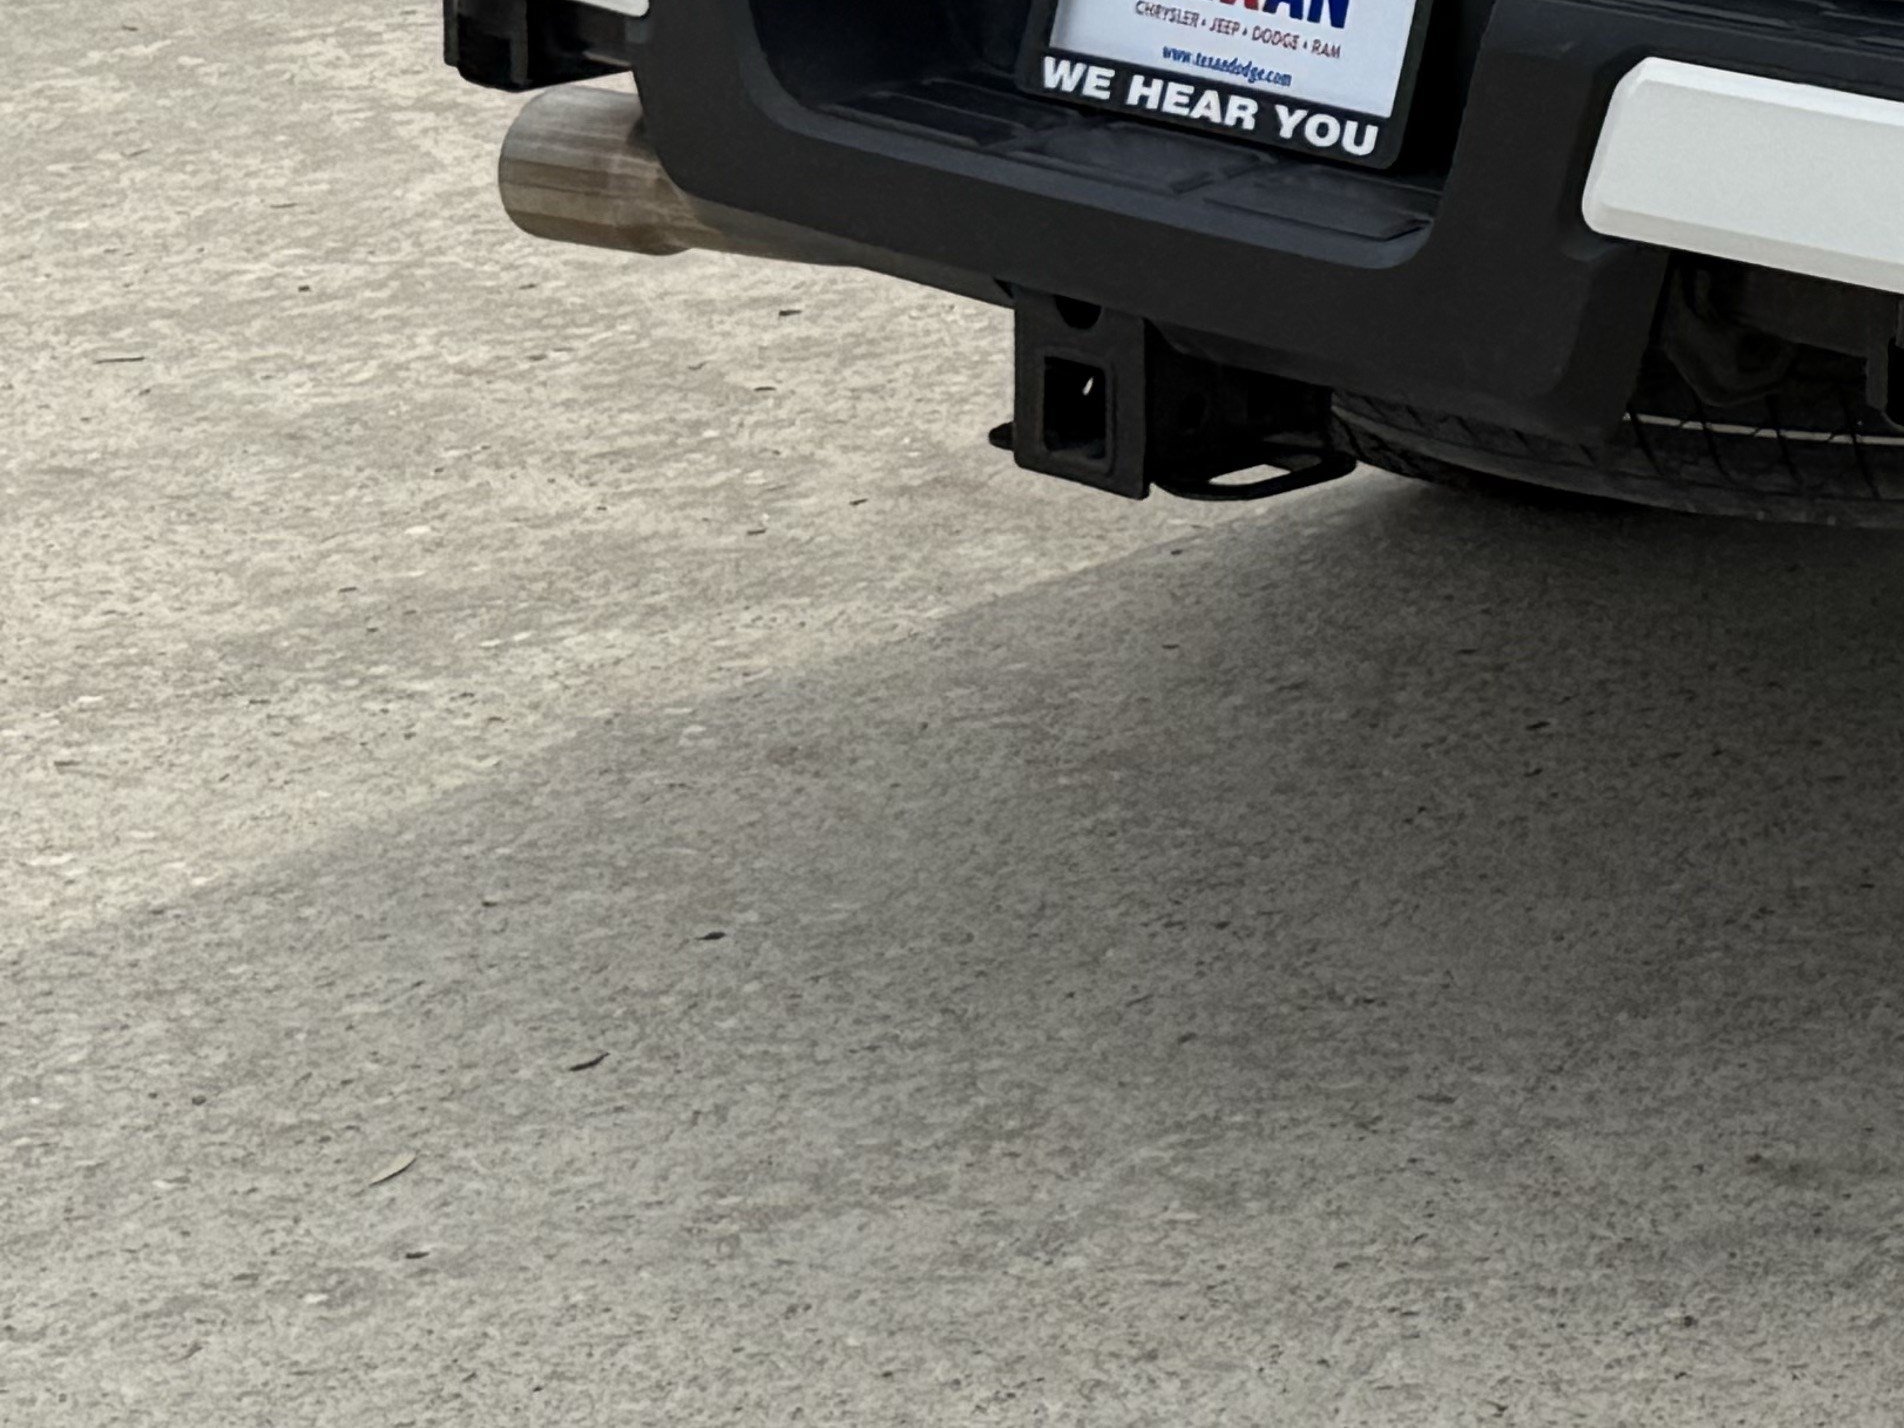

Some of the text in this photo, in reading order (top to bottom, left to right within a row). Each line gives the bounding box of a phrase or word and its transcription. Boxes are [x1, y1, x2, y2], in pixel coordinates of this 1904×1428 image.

[1135, 0, 1342, 60] CHRYSLER JEEP DODGE RAM
[1042, 55, 1380, 157] WE HEAR YOU
